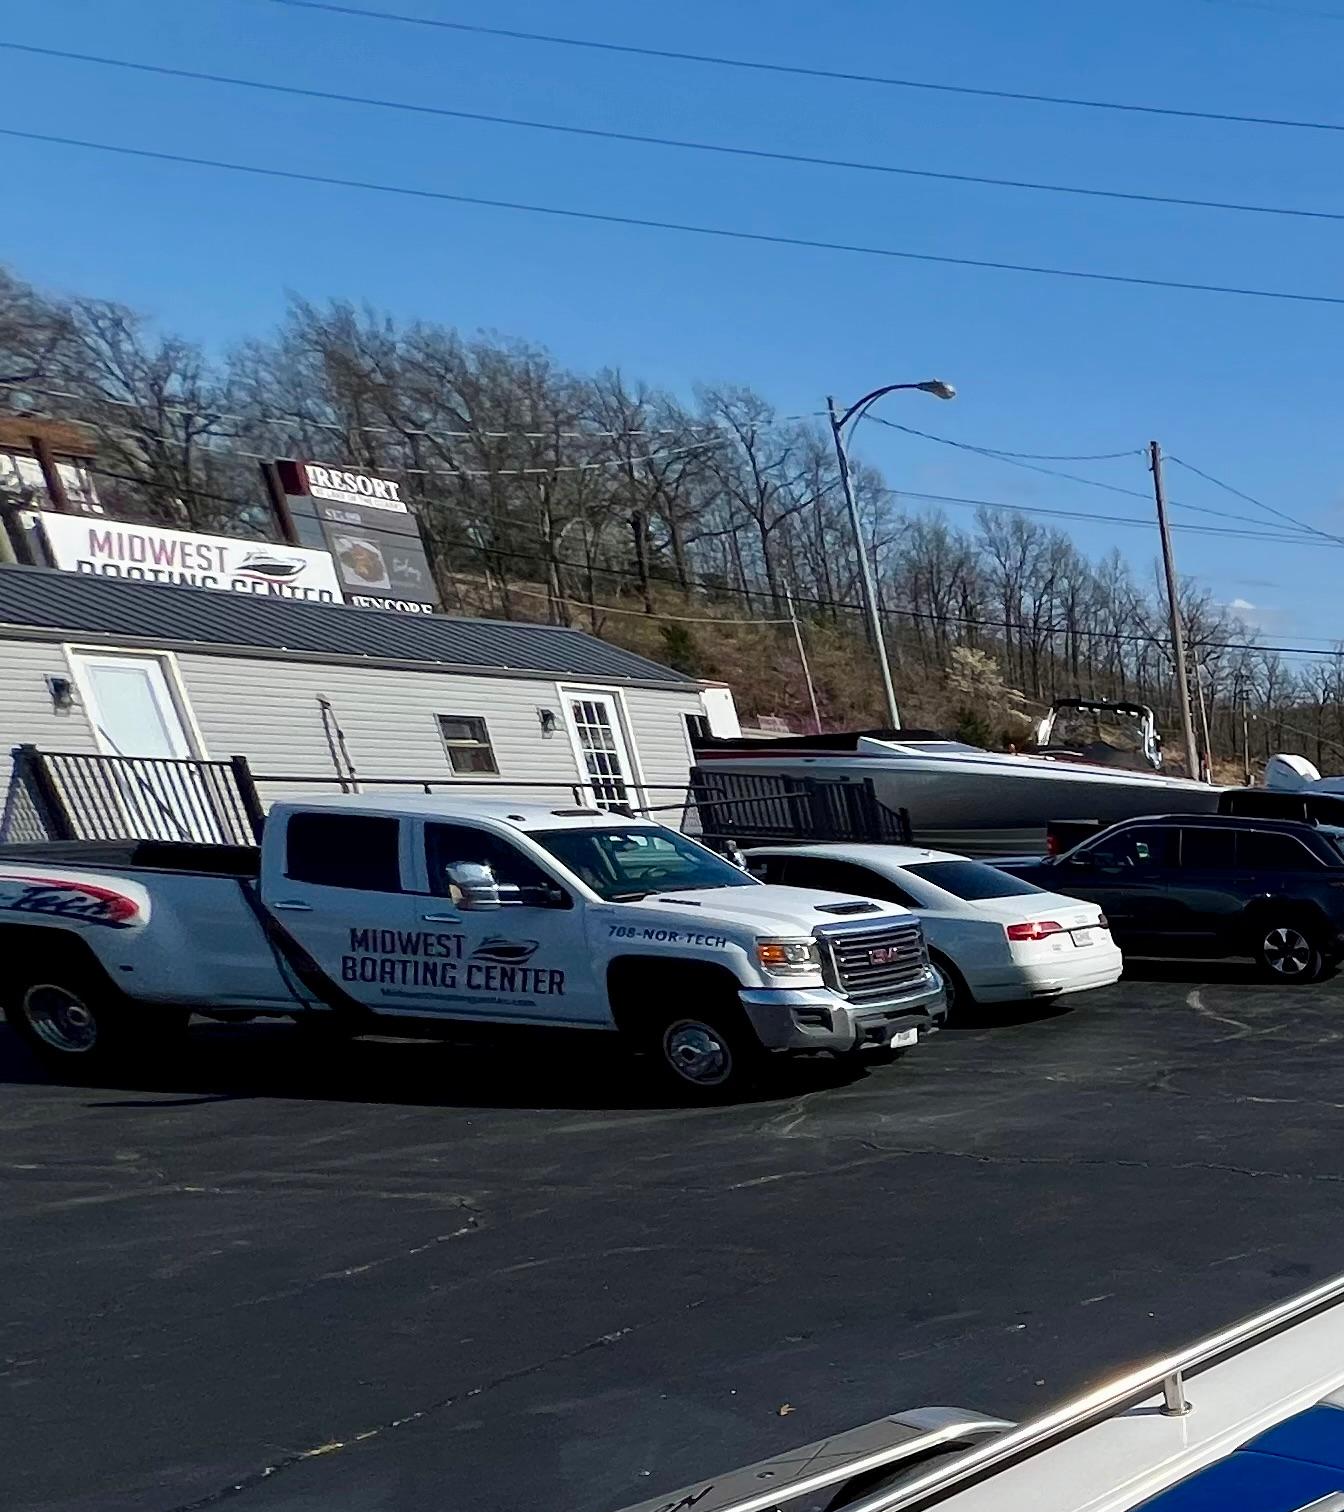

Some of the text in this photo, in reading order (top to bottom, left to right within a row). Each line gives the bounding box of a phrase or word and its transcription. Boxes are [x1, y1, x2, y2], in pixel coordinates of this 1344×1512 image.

[314, 465, 400, 501] RESORT
[87, 528, 229, 574] MIDWEST
[350, 927, 467, 960] MIDWEST
[607, 926, 727, 949] 708-NOR-TECH
[341, 955, 565, 996] BOATING CENTER
